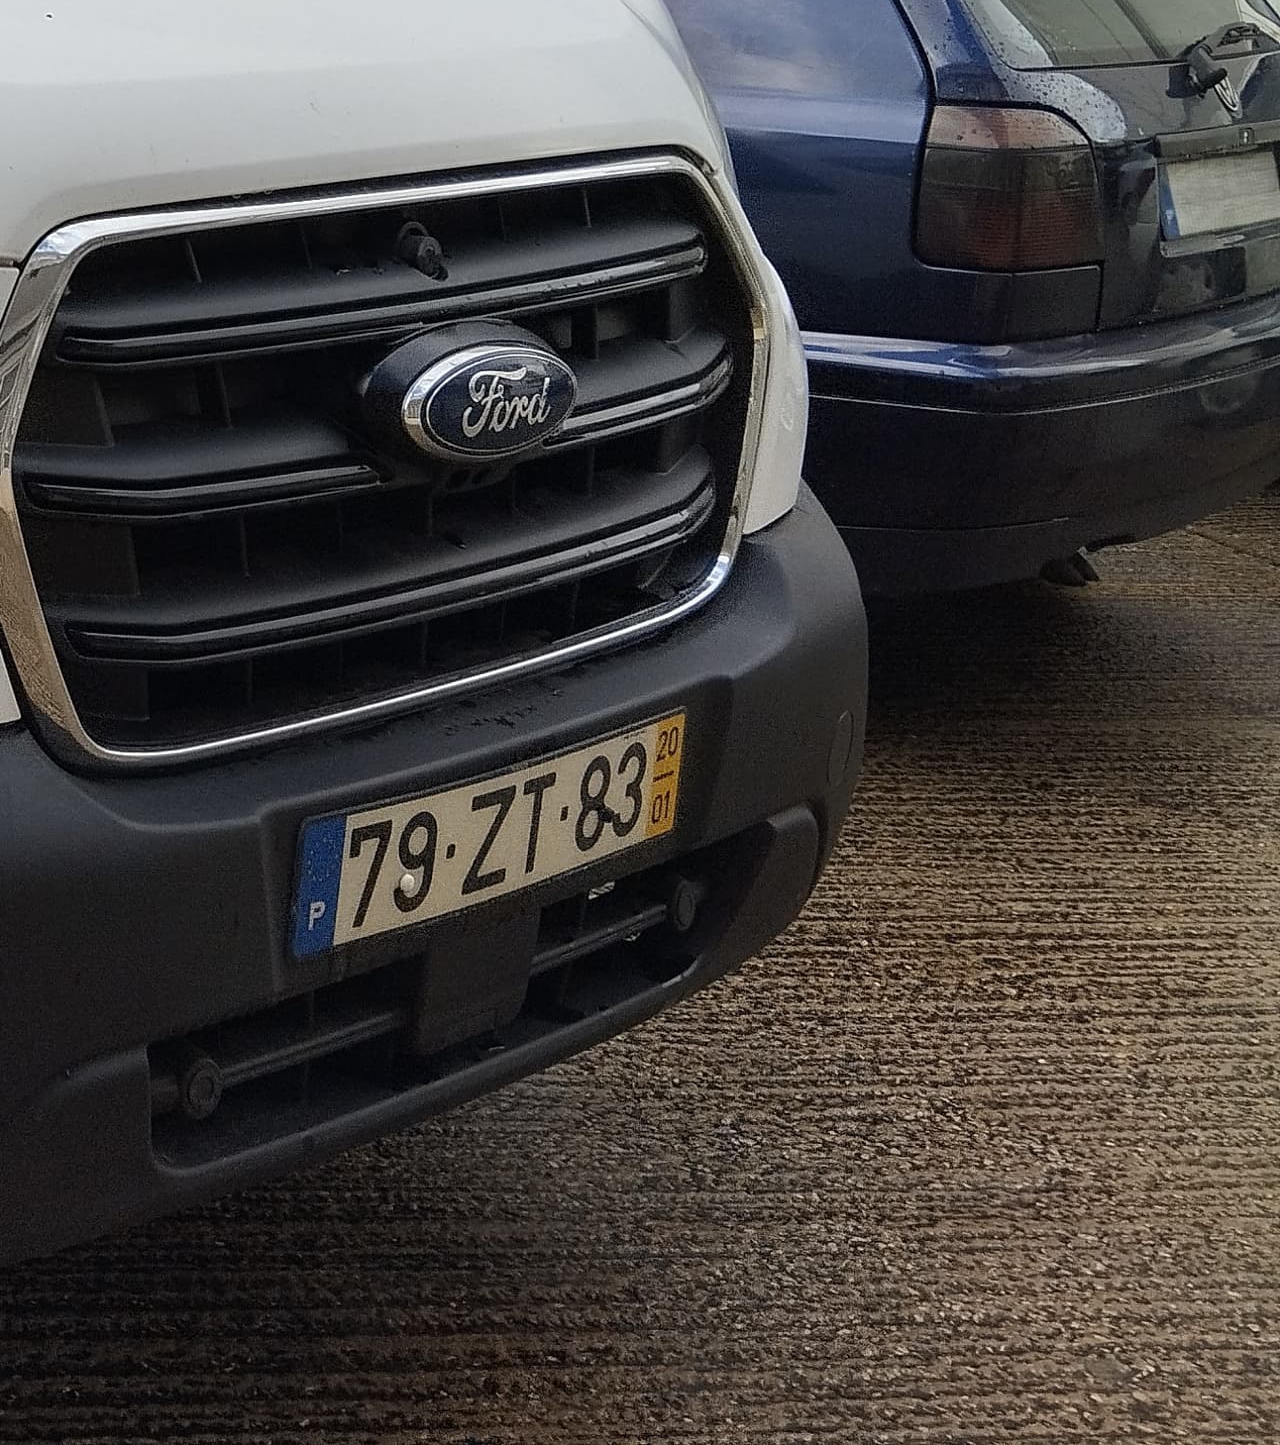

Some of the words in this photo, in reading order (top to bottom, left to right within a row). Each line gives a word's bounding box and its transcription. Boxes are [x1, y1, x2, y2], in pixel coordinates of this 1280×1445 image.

[462, 366, 550, 438] Ford
[655, 726, 679, 762] 20
[651, 790, 671, 824] 01
[308, 901, 326, 930] P
